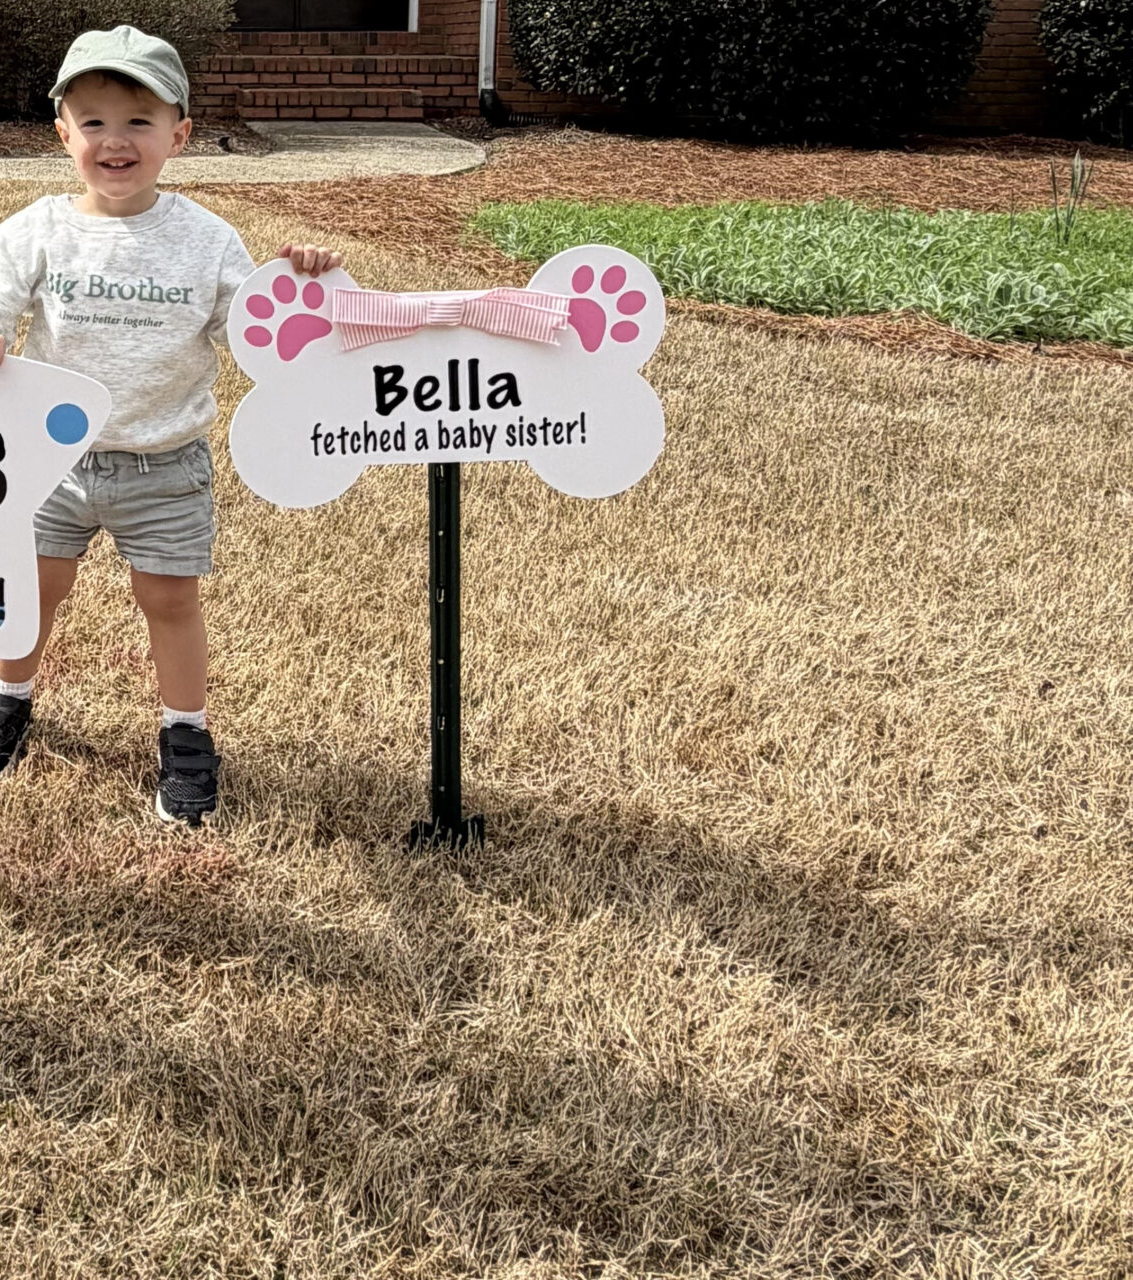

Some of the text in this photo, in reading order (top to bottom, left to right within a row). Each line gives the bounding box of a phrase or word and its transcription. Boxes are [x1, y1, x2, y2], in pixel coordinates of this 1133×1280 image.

[84, 274, 194, 305] Brother
[59, 309, 165, 329] lways better together
[372, 357, 523, 417] Bella
[310, 411, 586, 456] fetched a baby sister!
